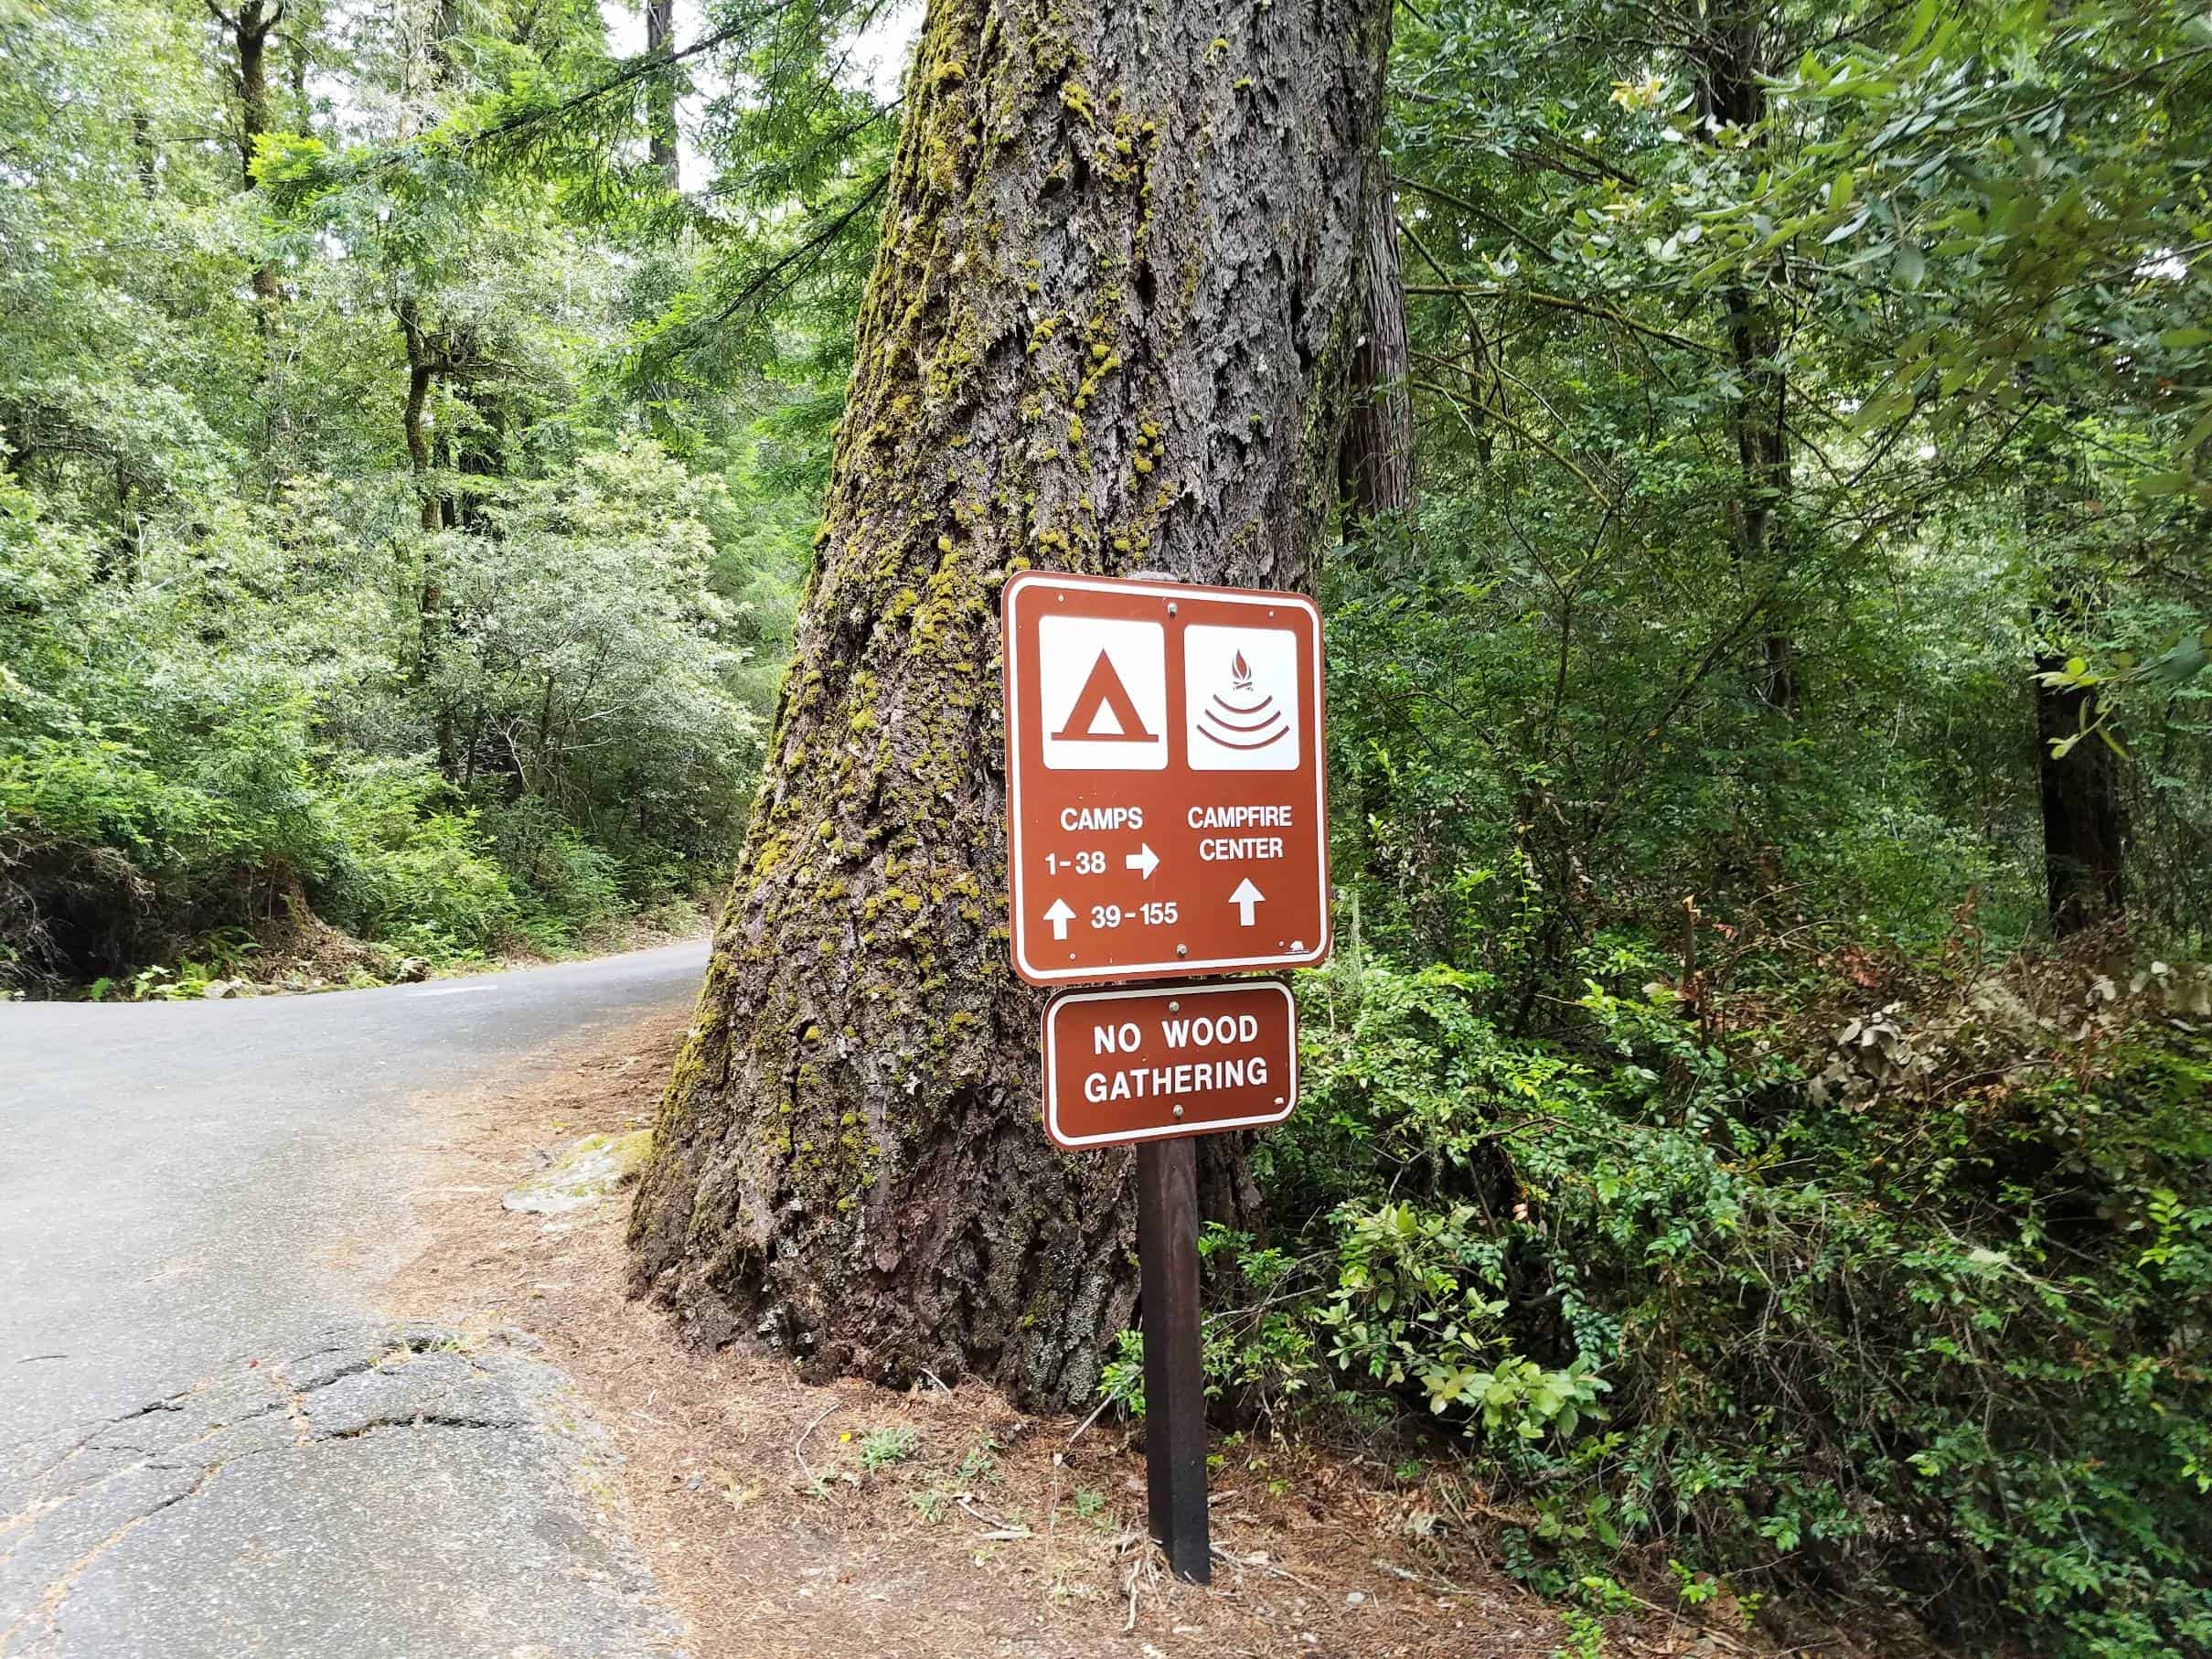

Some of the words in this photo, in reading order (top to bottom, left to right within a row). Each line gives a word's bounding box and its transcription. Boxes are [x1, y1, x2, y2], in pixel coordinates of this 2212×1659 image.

[1060, 807, 1144, 831] CAMPS
[1187, 805, 1293, 829] CAMPFIRE
[1199, 837, 1284, 862] CENTER
[1044, 851, 1107, 875] 1-38
[1090, 902, 1179, 929] 39-155
[1094, 1022, 1142, 1054] NO
[1161, 1015, 1259, 1048] WOOD
[1084, 1056, 1268, 1104] GATHERING
